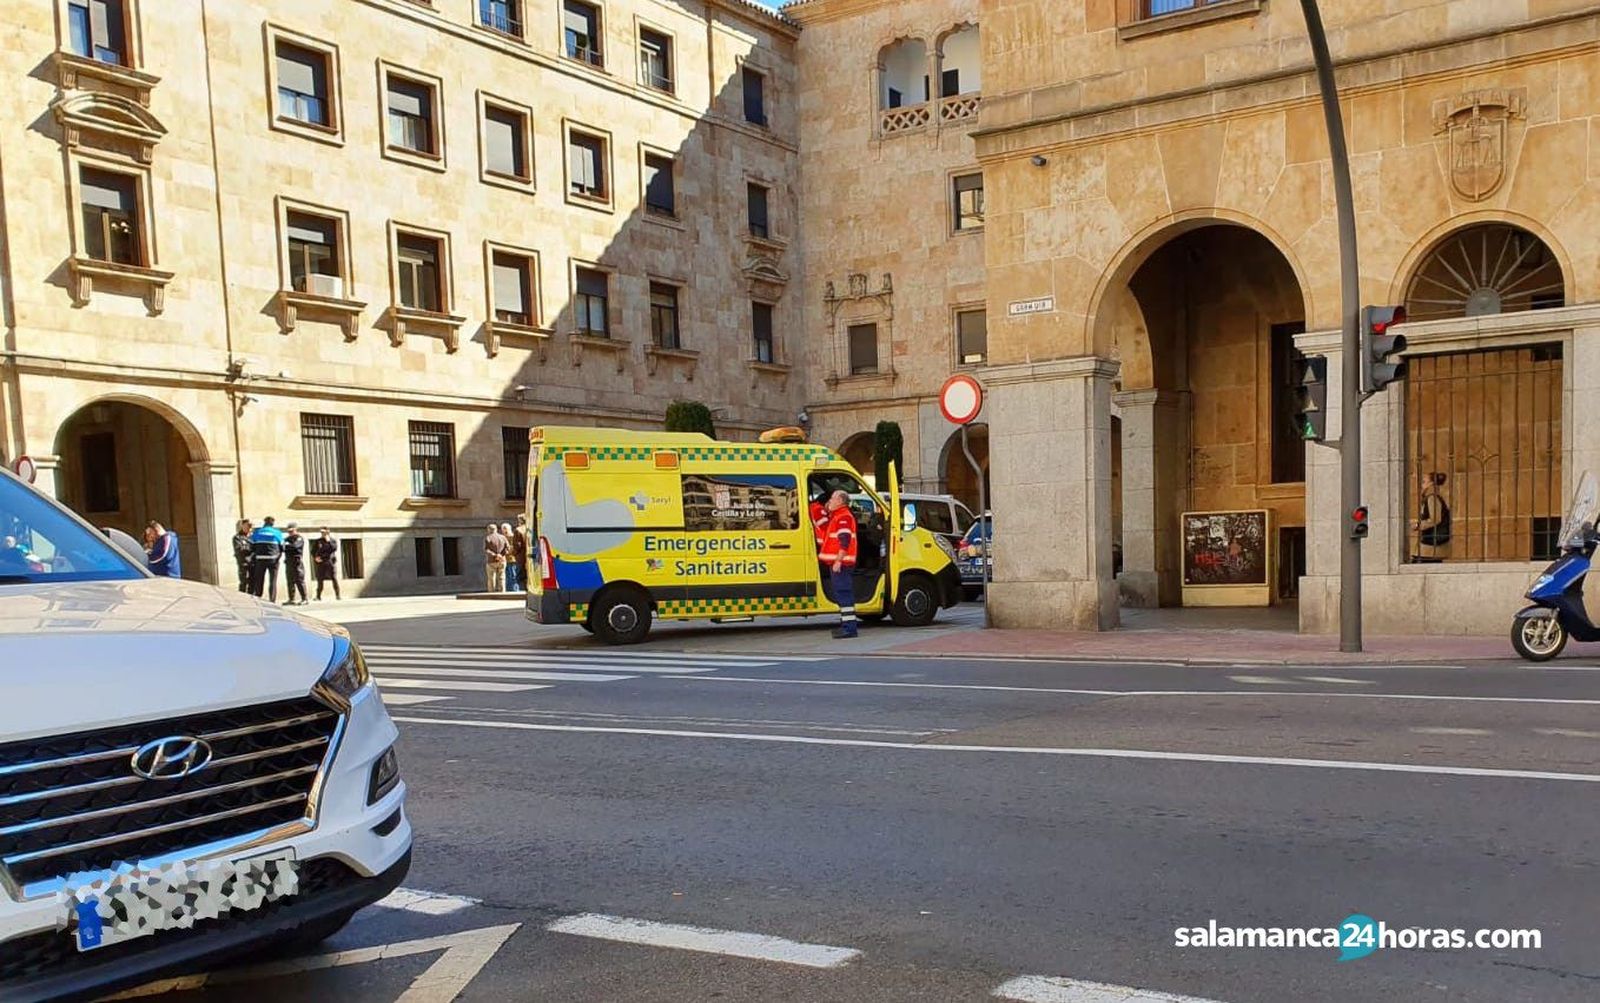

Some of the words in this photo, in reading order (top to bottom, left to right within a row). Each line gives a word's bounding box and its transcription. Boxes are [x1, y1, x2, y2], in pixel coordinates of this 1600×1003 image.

[711, 509, 739, 517] Castilla
[739, 510, 745, 518] y
[644, 536, 766, 555] Emergencias
[675, 560, 767, 576] Sanitarias
